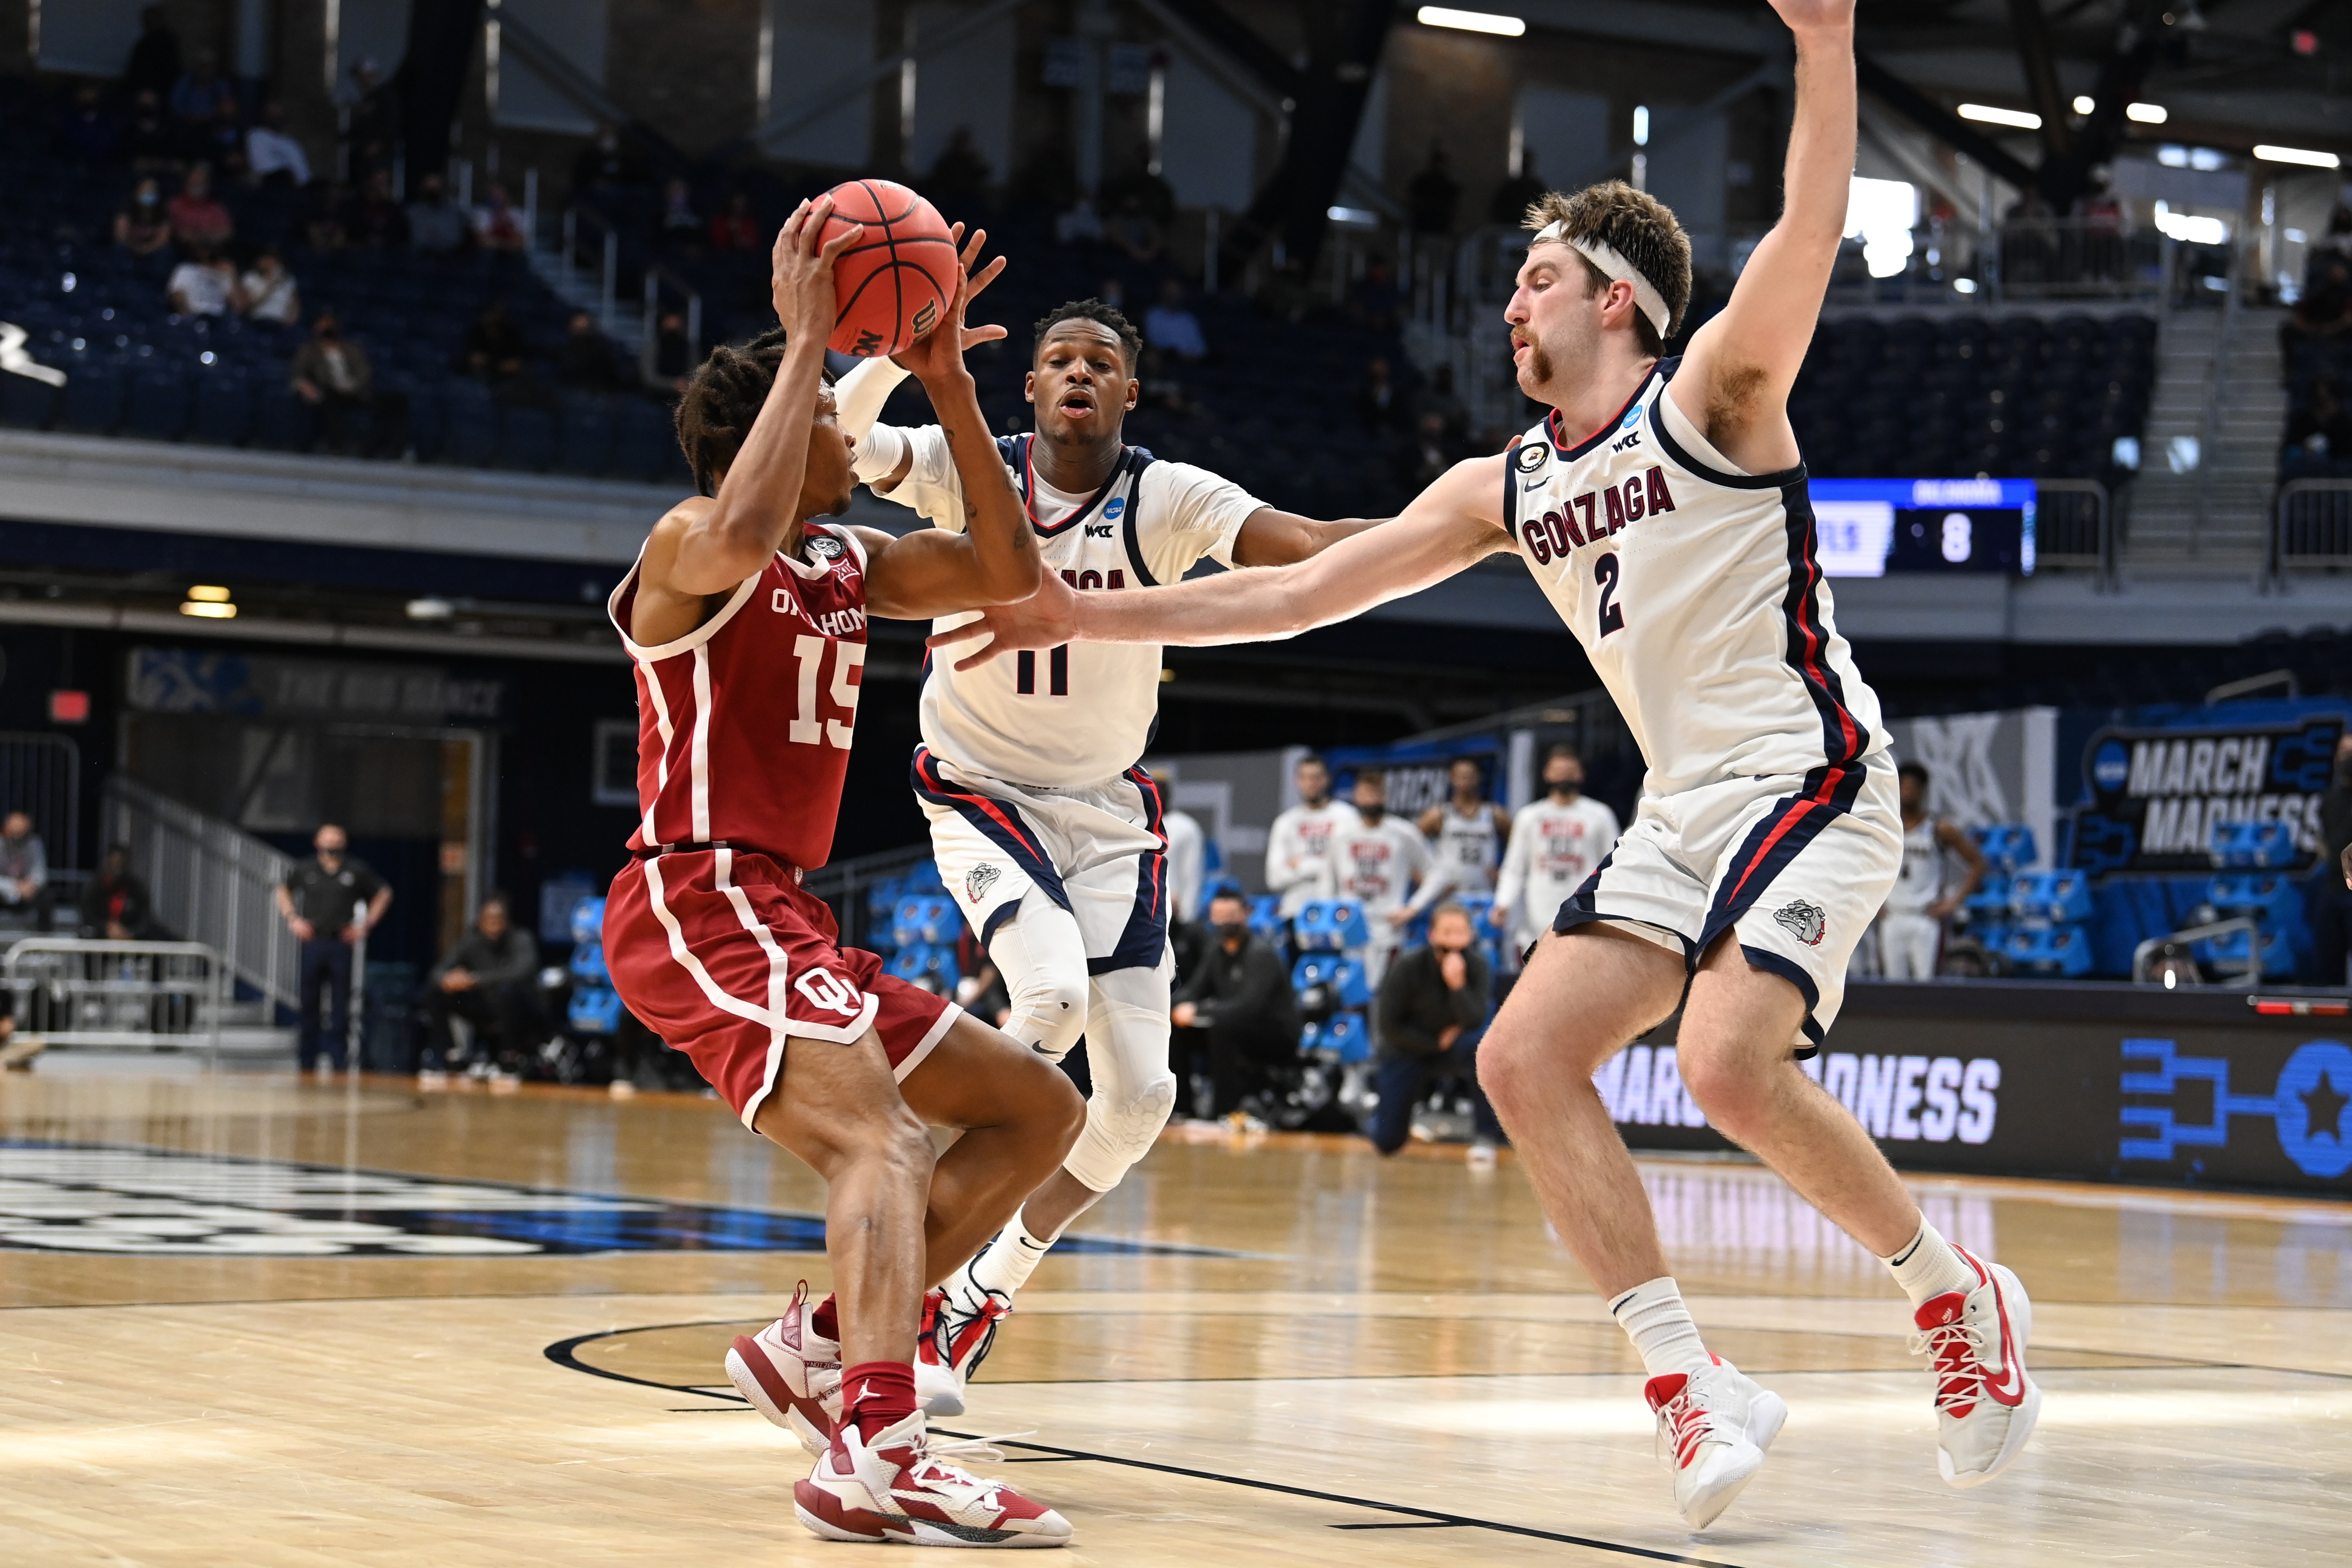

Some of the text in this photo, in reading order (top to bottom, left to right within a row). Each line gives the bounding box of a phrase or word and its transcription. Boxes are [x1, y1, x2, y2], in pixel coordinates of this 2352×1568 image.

[1612, 430, 1641, 454] WCC
[1084, 524, 1114, 538] WCC
[1522, 466, 1676, 566] GONZAGA
[1942, 512, 1972, 563] 8
[1594, 552, 1625, 639] 2
[789, 634, 867, 750] 15
[2127, 736, 2270, 798] MARCH
[794, 967, 861, 1017] OU
